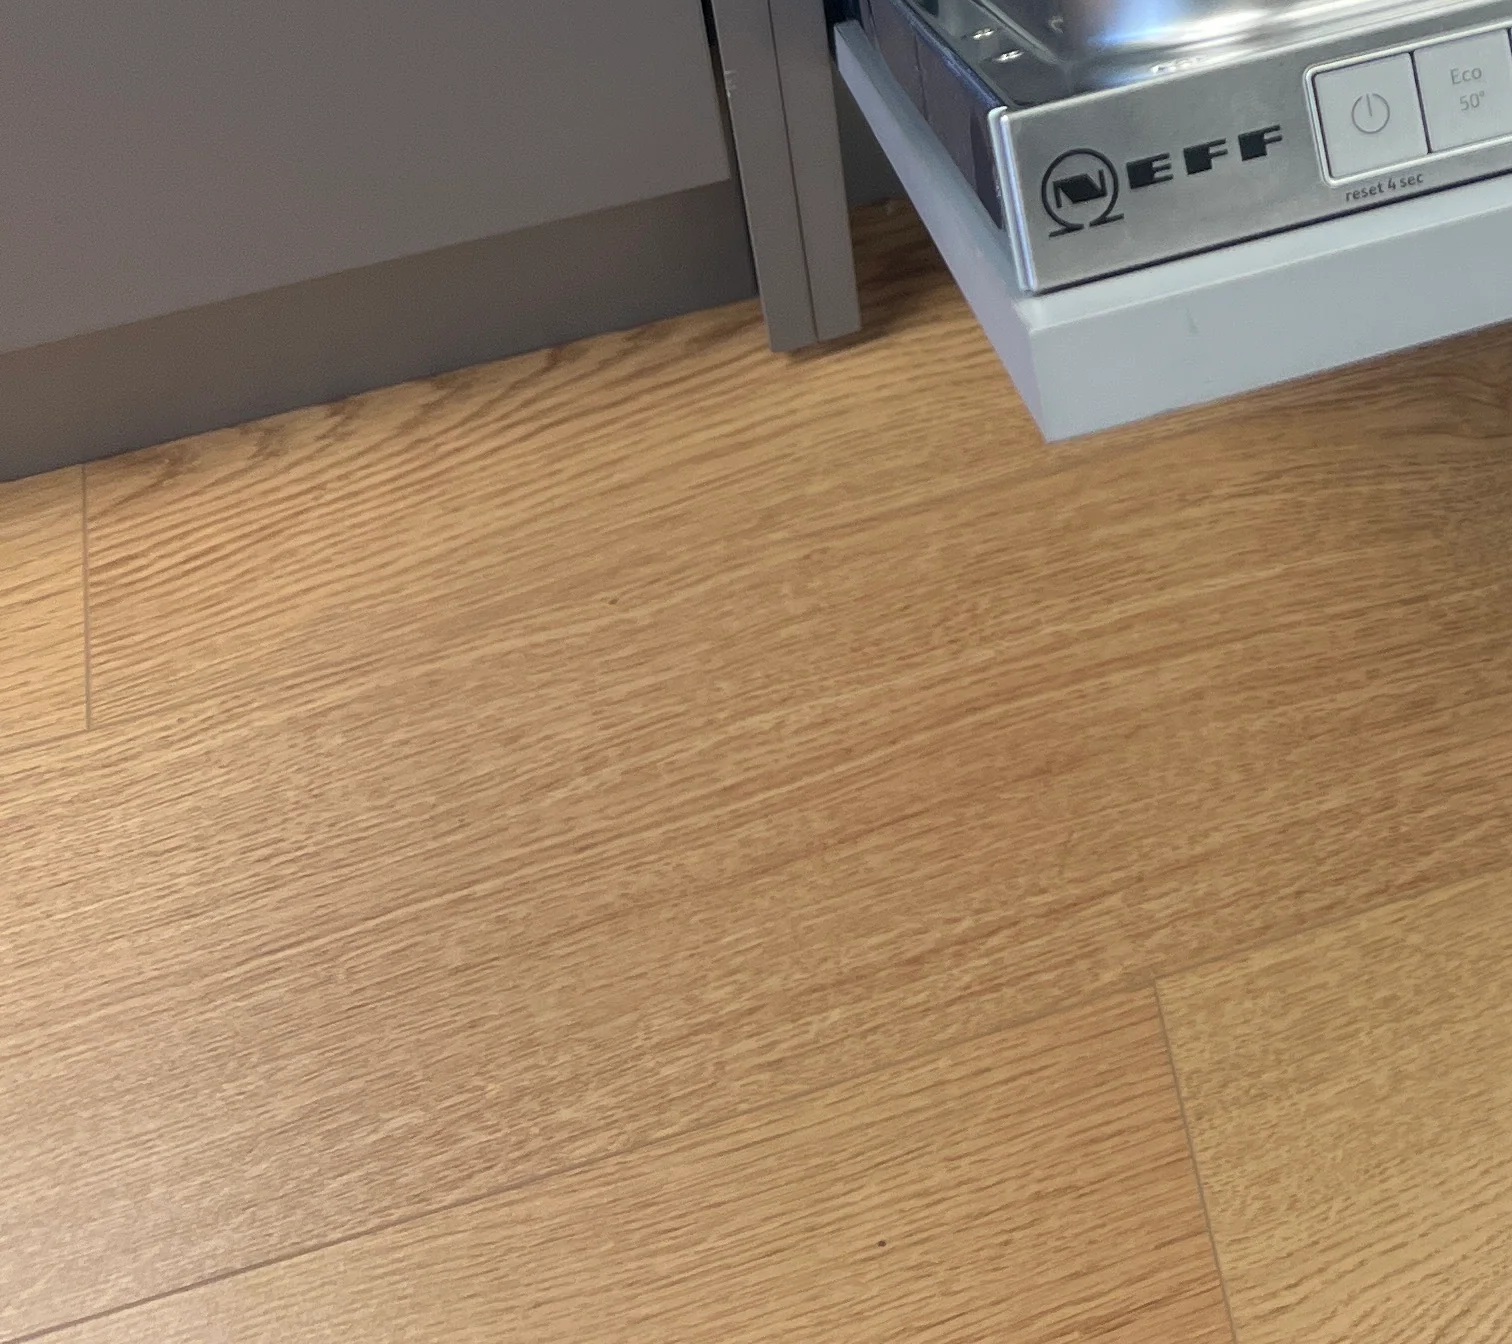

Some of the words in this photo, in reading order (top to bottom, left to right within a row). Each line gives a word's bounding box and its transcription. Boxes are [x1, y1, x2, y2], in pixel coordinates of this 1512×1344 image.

[1450, 64, 1482, 85] Eco
[1459, 90, 1485, 111] 50°
[1042, 125, 1283, 236] NEFF
[1345, 181, 1383, 203] reset
[1399, 172, 1424, 190] sec
